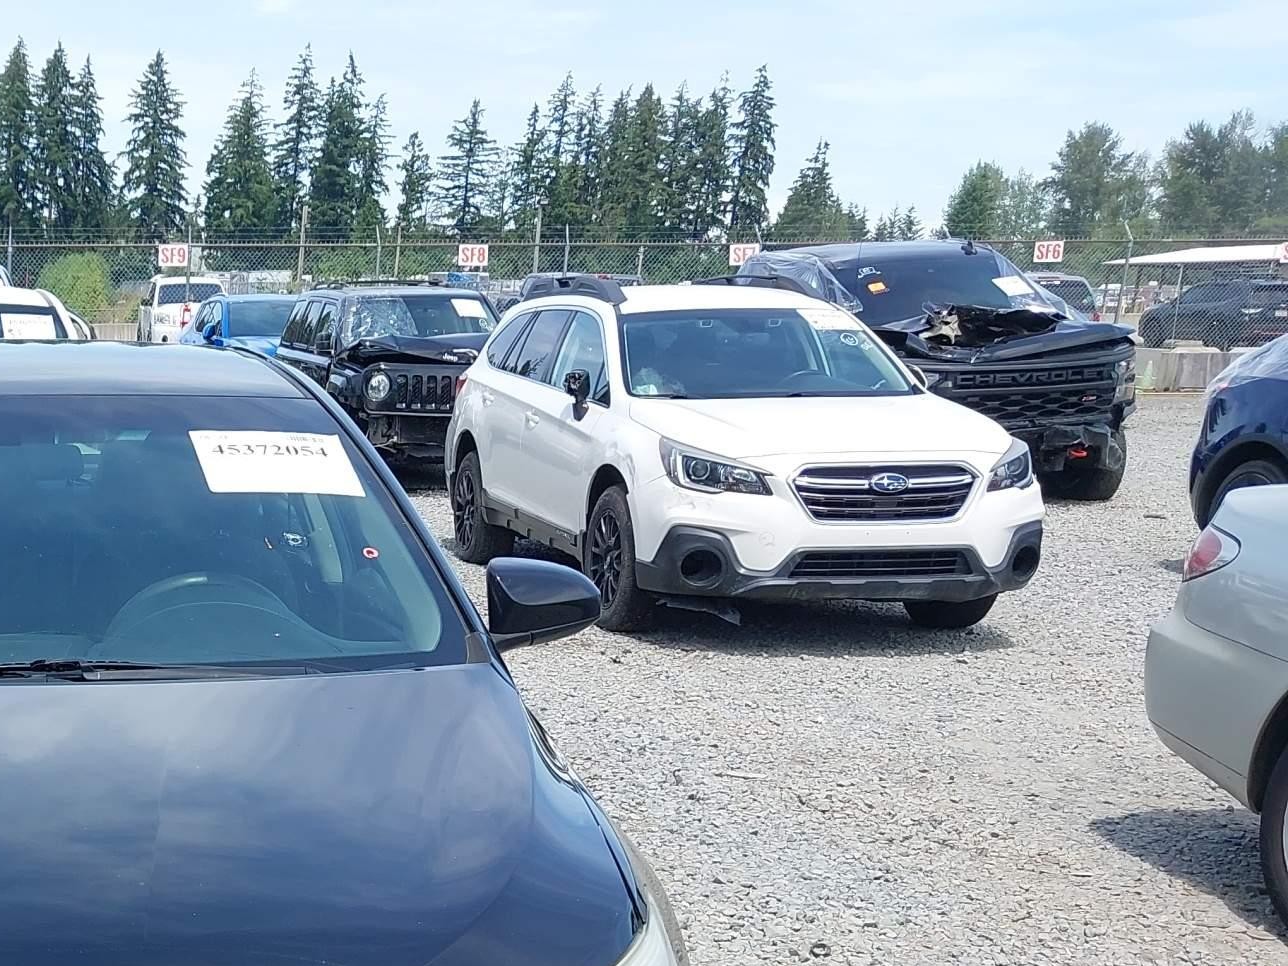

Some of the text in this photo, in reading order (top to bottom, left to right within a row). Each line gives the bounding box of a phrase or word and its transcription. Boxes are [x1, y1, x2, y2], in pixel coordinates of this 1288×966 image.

[161, 247, 186, 263] SF9
[461, 247, 485, 263] SF8
[1036, 244, 1061, 260] SF6
[211, 444, 329, 457] 45372054
